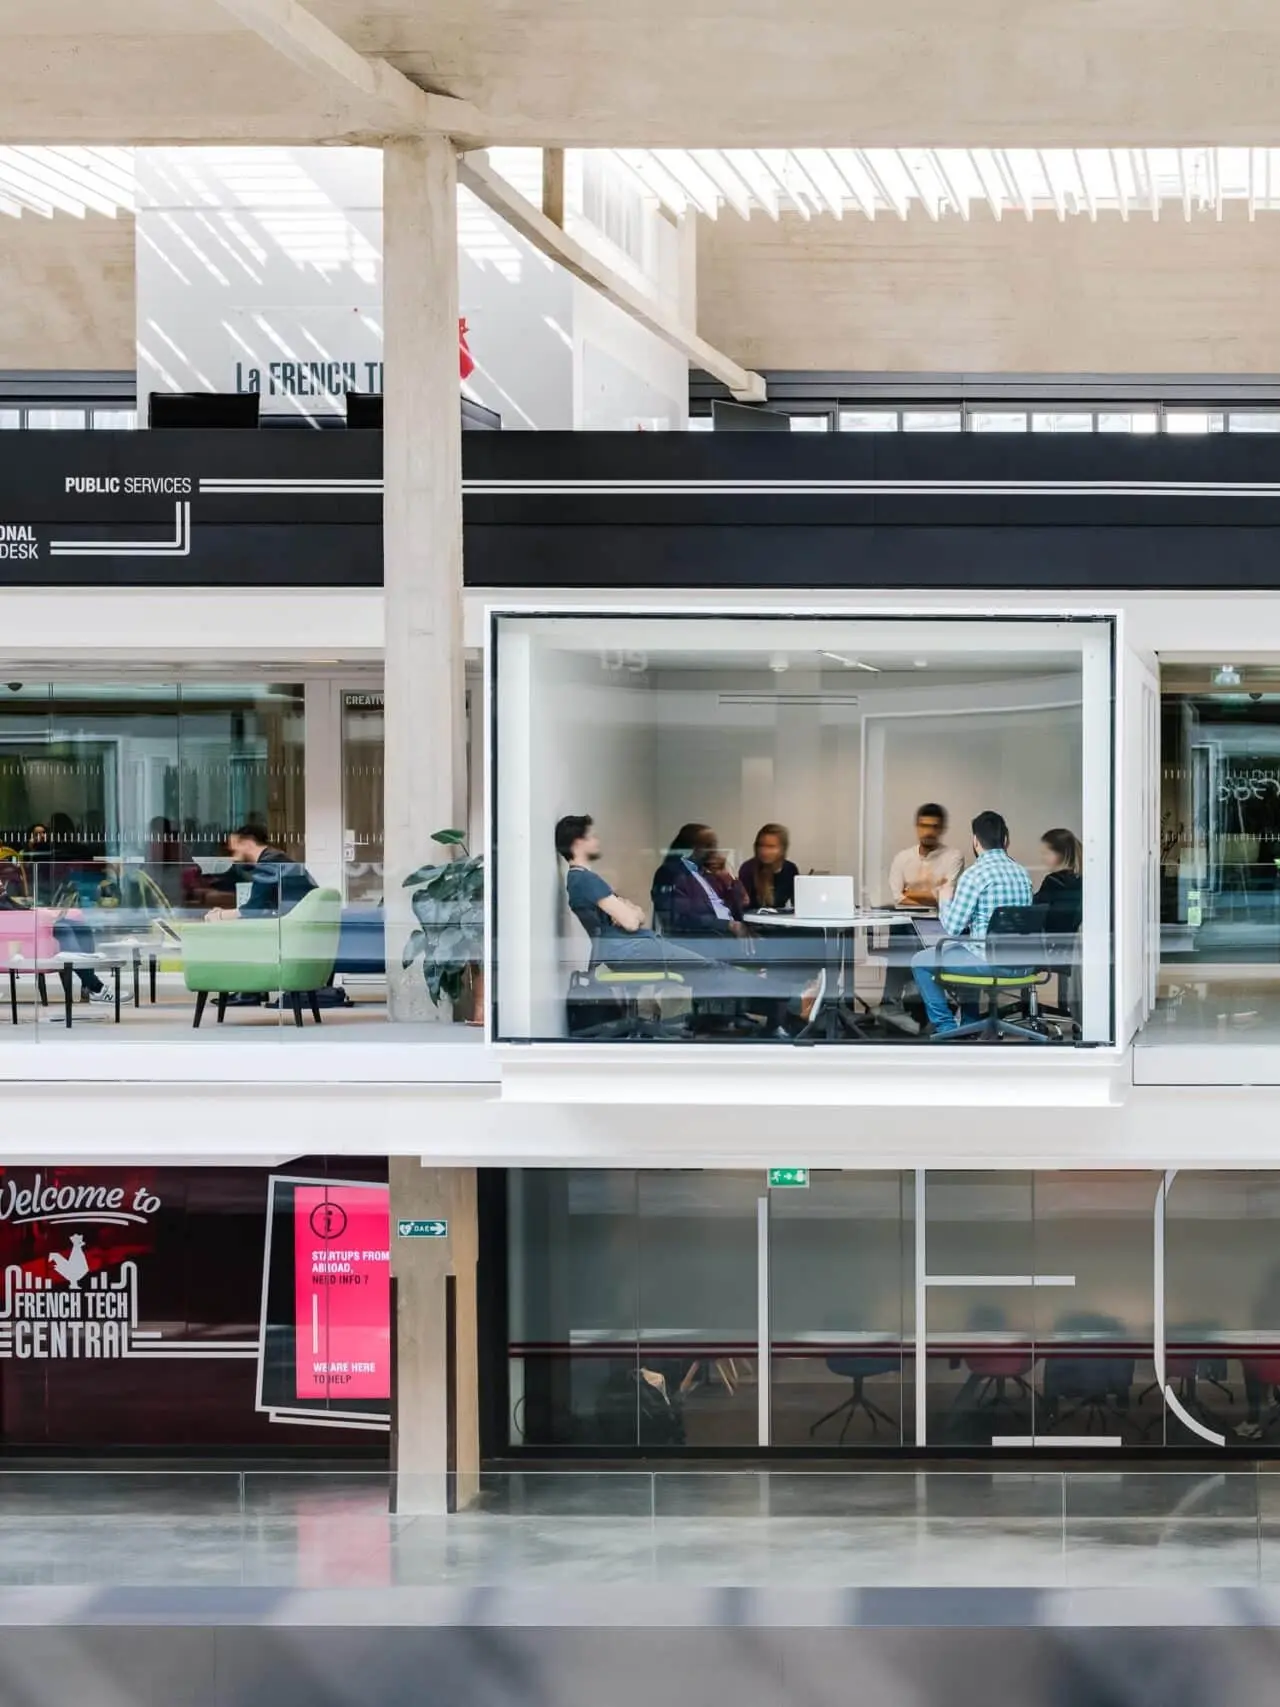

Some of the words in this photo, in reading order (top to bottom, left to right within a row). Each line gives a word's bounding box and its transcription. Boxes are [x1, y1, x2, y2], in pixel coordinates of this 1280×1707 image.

[236, 362, 260, 394] La
[269, 362, 356, 396] FRENCH
[364, 362, 384, 394] T
[65, 477, 120, 493] PUBLIC
[123, 477, 192, 494] SERVICES
[0, 1174, 124, 1221] Welcome
[133, 1187, 161, 1214] to
[312, 1250, 360, 1262] STARTUPS
[362, 1250, 390, 1262] FROM
[312, 1275, 336, 1285] NEED
[339, 1275, 361, 1285] INFO
[15, 1292, 81, 1319] FRENCH
[84, 1292, 128, 1319] TECH
[15, 1320, 129, 1359] CENTRAL
[313, 1362, 328, 1373] WE
[329, 1362, 349, 1373] ARE
[351, 1362, 376, 1373] HERE
[313, 1375, 325, 1384] TO
[328, 1375, 352, 1384] HELP
